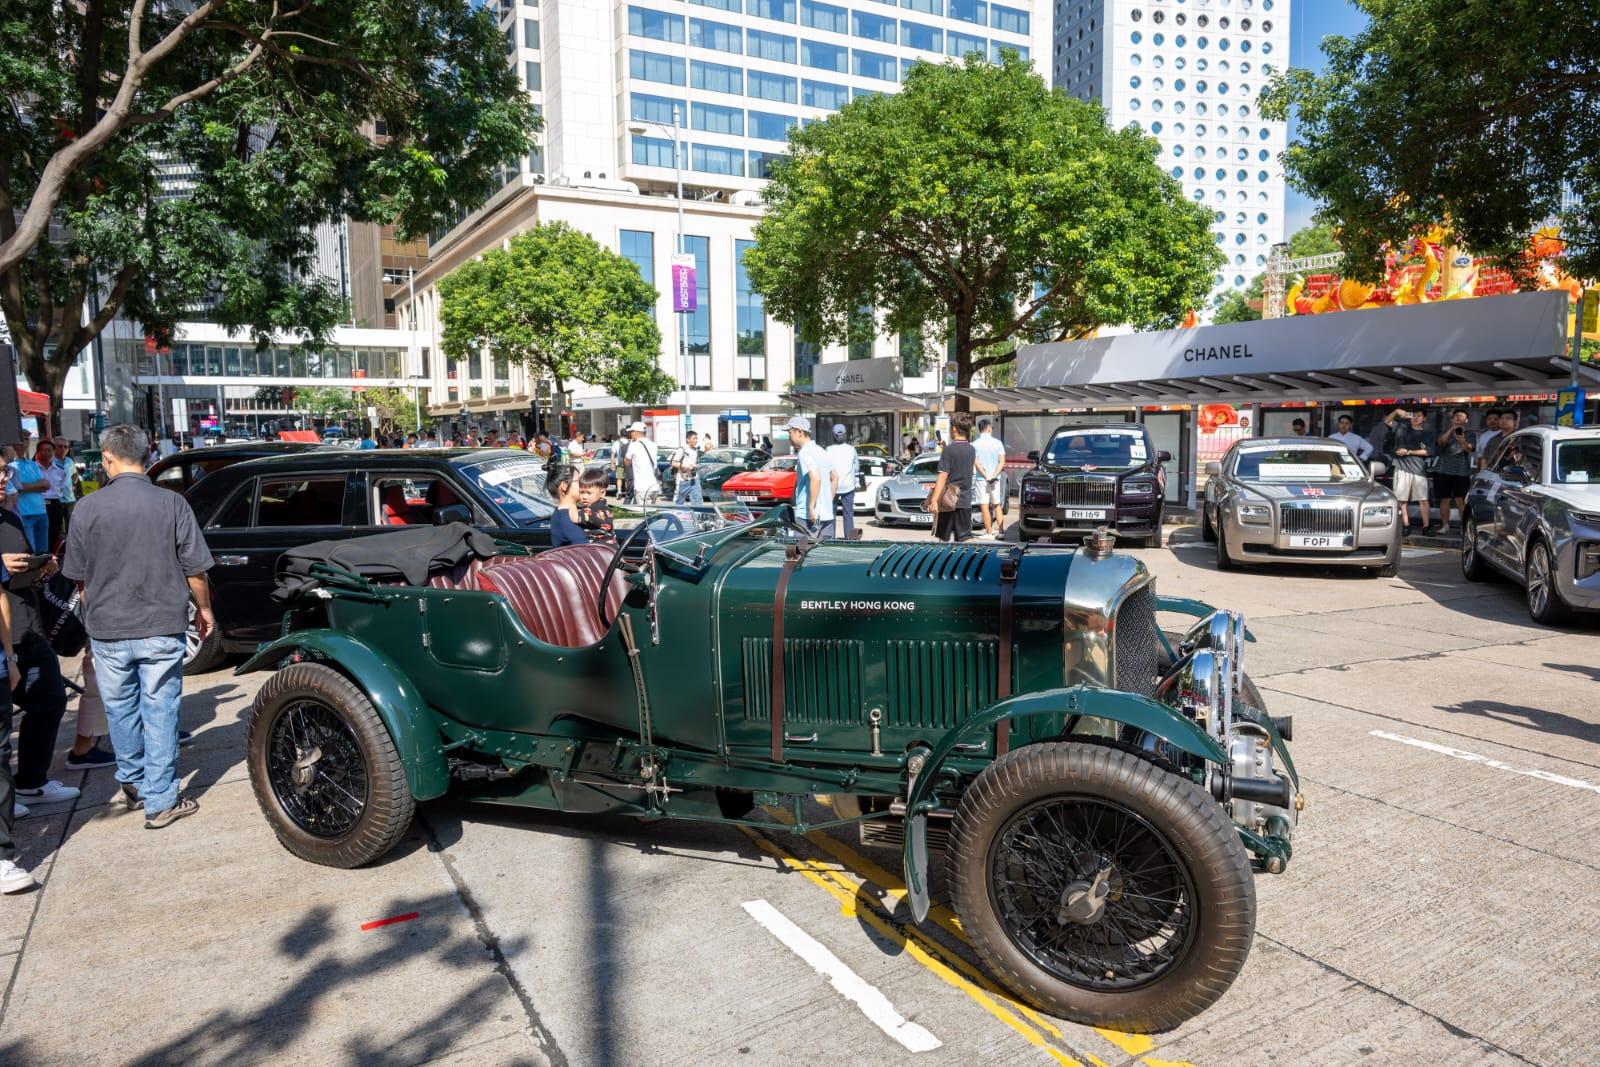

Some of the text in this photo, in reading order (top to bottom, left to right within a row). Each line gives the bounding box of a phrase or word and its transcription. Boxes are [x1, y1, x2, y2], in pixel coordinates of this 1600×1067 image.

[1184, 344, 1253, 362] CHANEL
[835, 373, 865, 385] CHANEL
[1071, 510, 1100, 519] RH 169
[801, 600, 915, 610] BENTLEY HONG KONG
